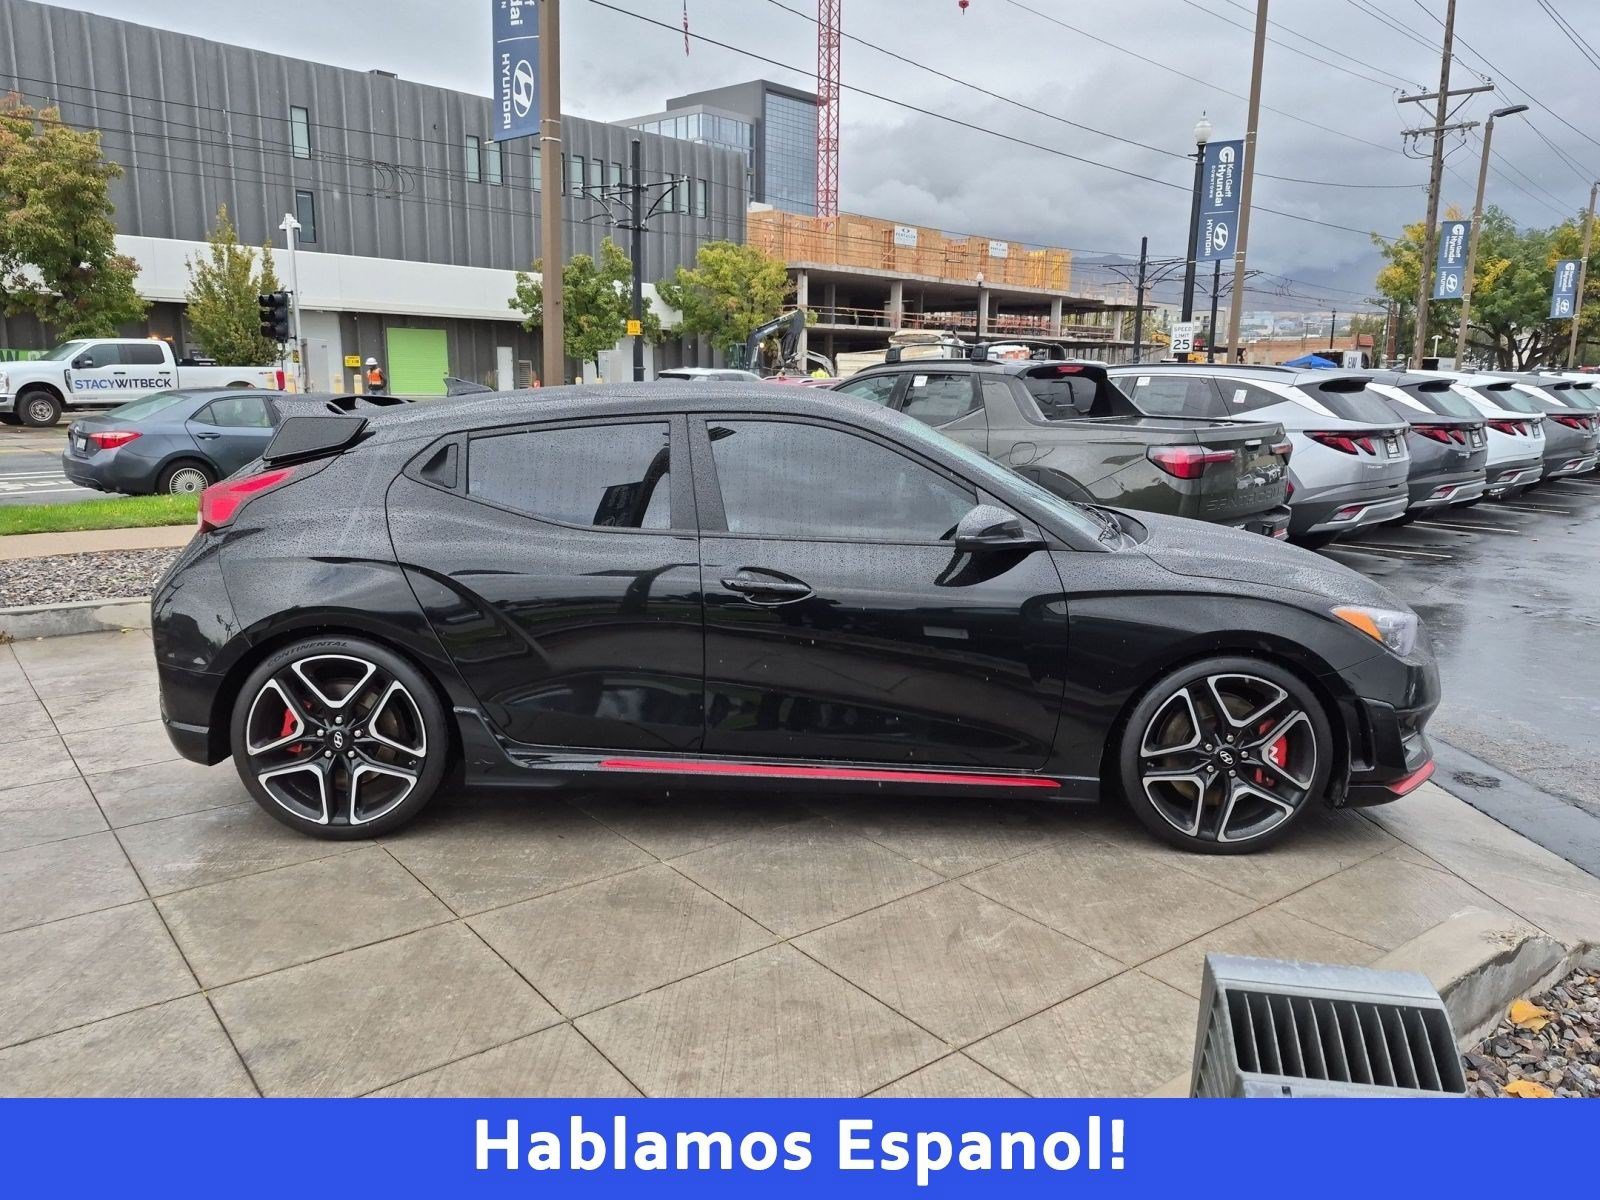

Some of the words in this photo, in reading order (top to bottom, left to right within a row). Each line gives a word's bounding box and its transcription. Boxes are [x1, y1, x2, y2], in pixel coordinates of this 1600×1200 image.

[502, 53, 512, 129] HYUNDAI
[1226, 163, 1234, 179] Ken
[1215, 164, 1227, 207] Hyundai
[1224, 179, 1233, 198] Garff
[1204, 219, 1214, 257] HYUNDAI
[1173, 339, 1190, 350] 25
[74, 378, 172, 390] STACYWITBECK
[266, 641, 348, 668] CONTINENTAL
